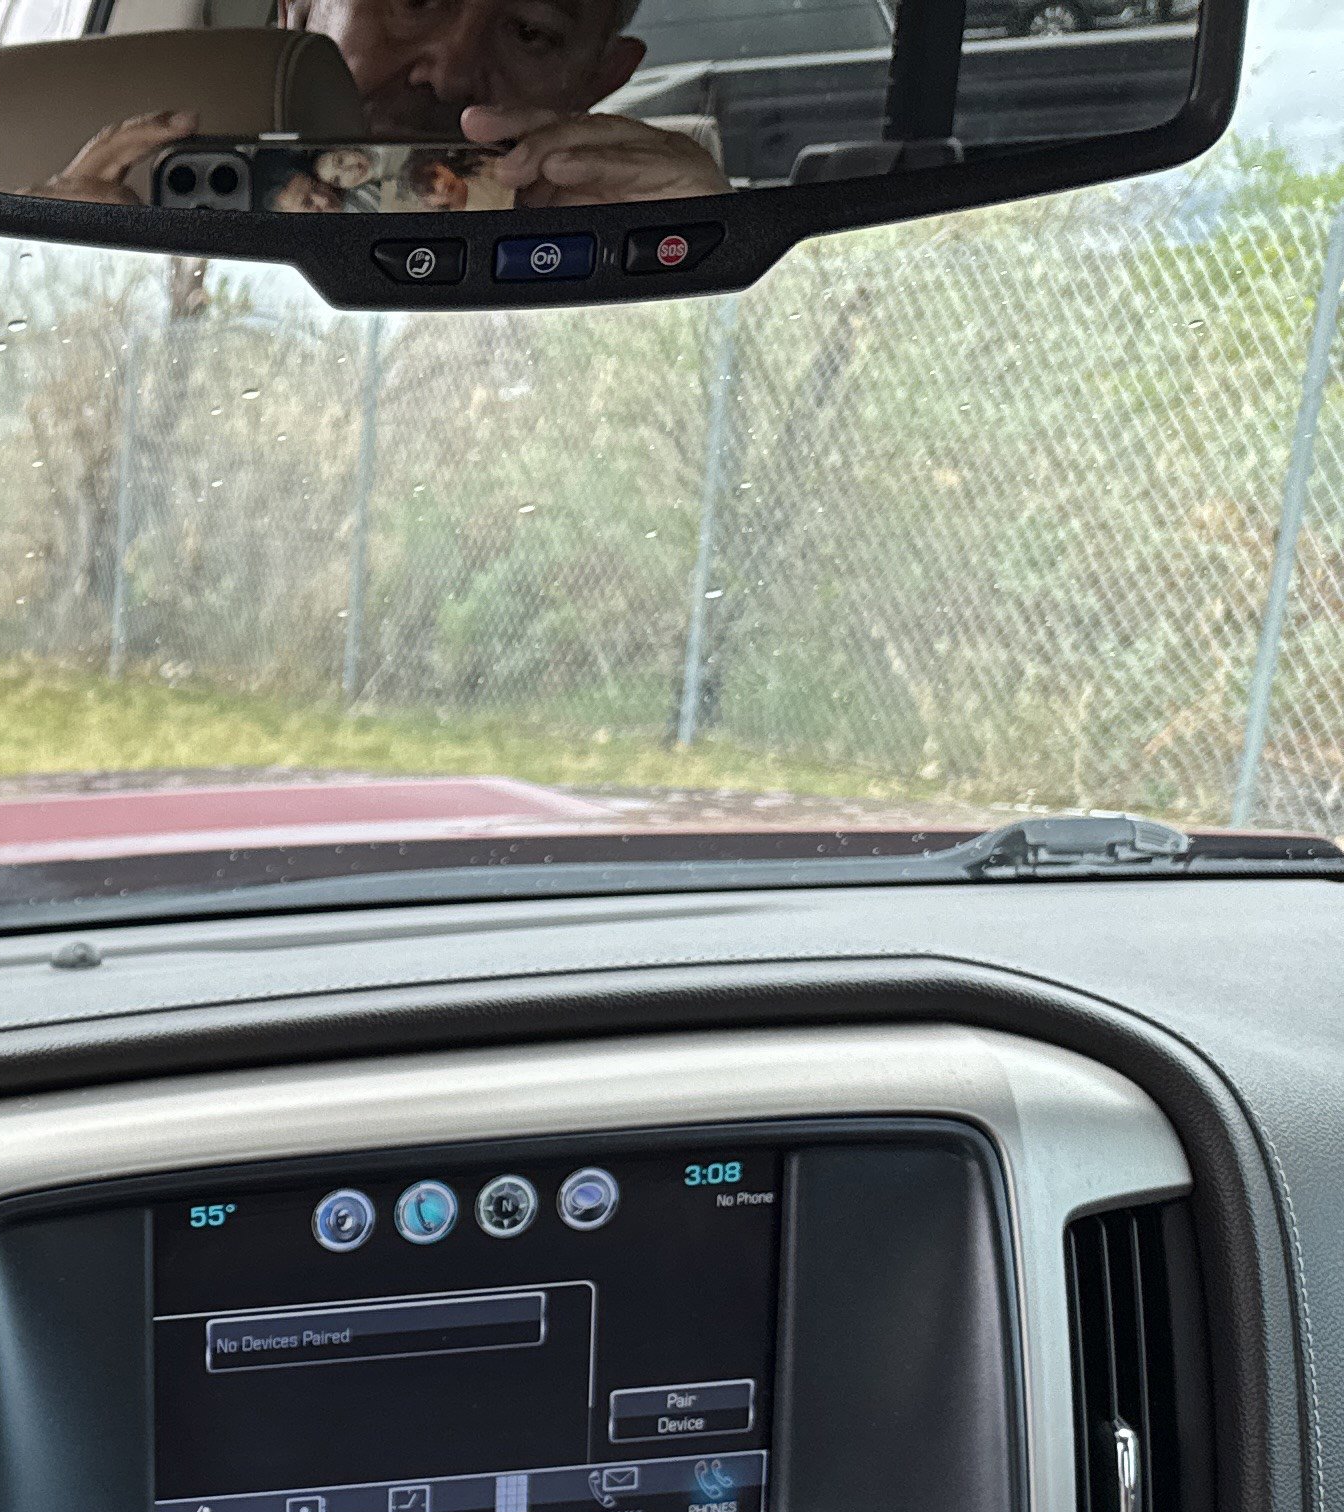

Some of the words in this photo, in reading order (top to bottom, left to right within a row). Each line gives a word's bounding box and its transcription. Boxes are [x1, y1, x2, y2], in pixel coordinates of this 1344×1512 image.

[660, 242, 685, 258] SOS
[683, 1161, 742, 1187] 3:08
[716, 1193, 733, 1208] No
[736, 1191, 774, 1206] Phone
[216, 1337, 237, 1355] No
[241, 1332, 298, 1353] Devices
[302, 1328, 351, 1347] Paired
[666, 1393, 697, 1409] Pair
[657, 1417, 704, 1434] Device
